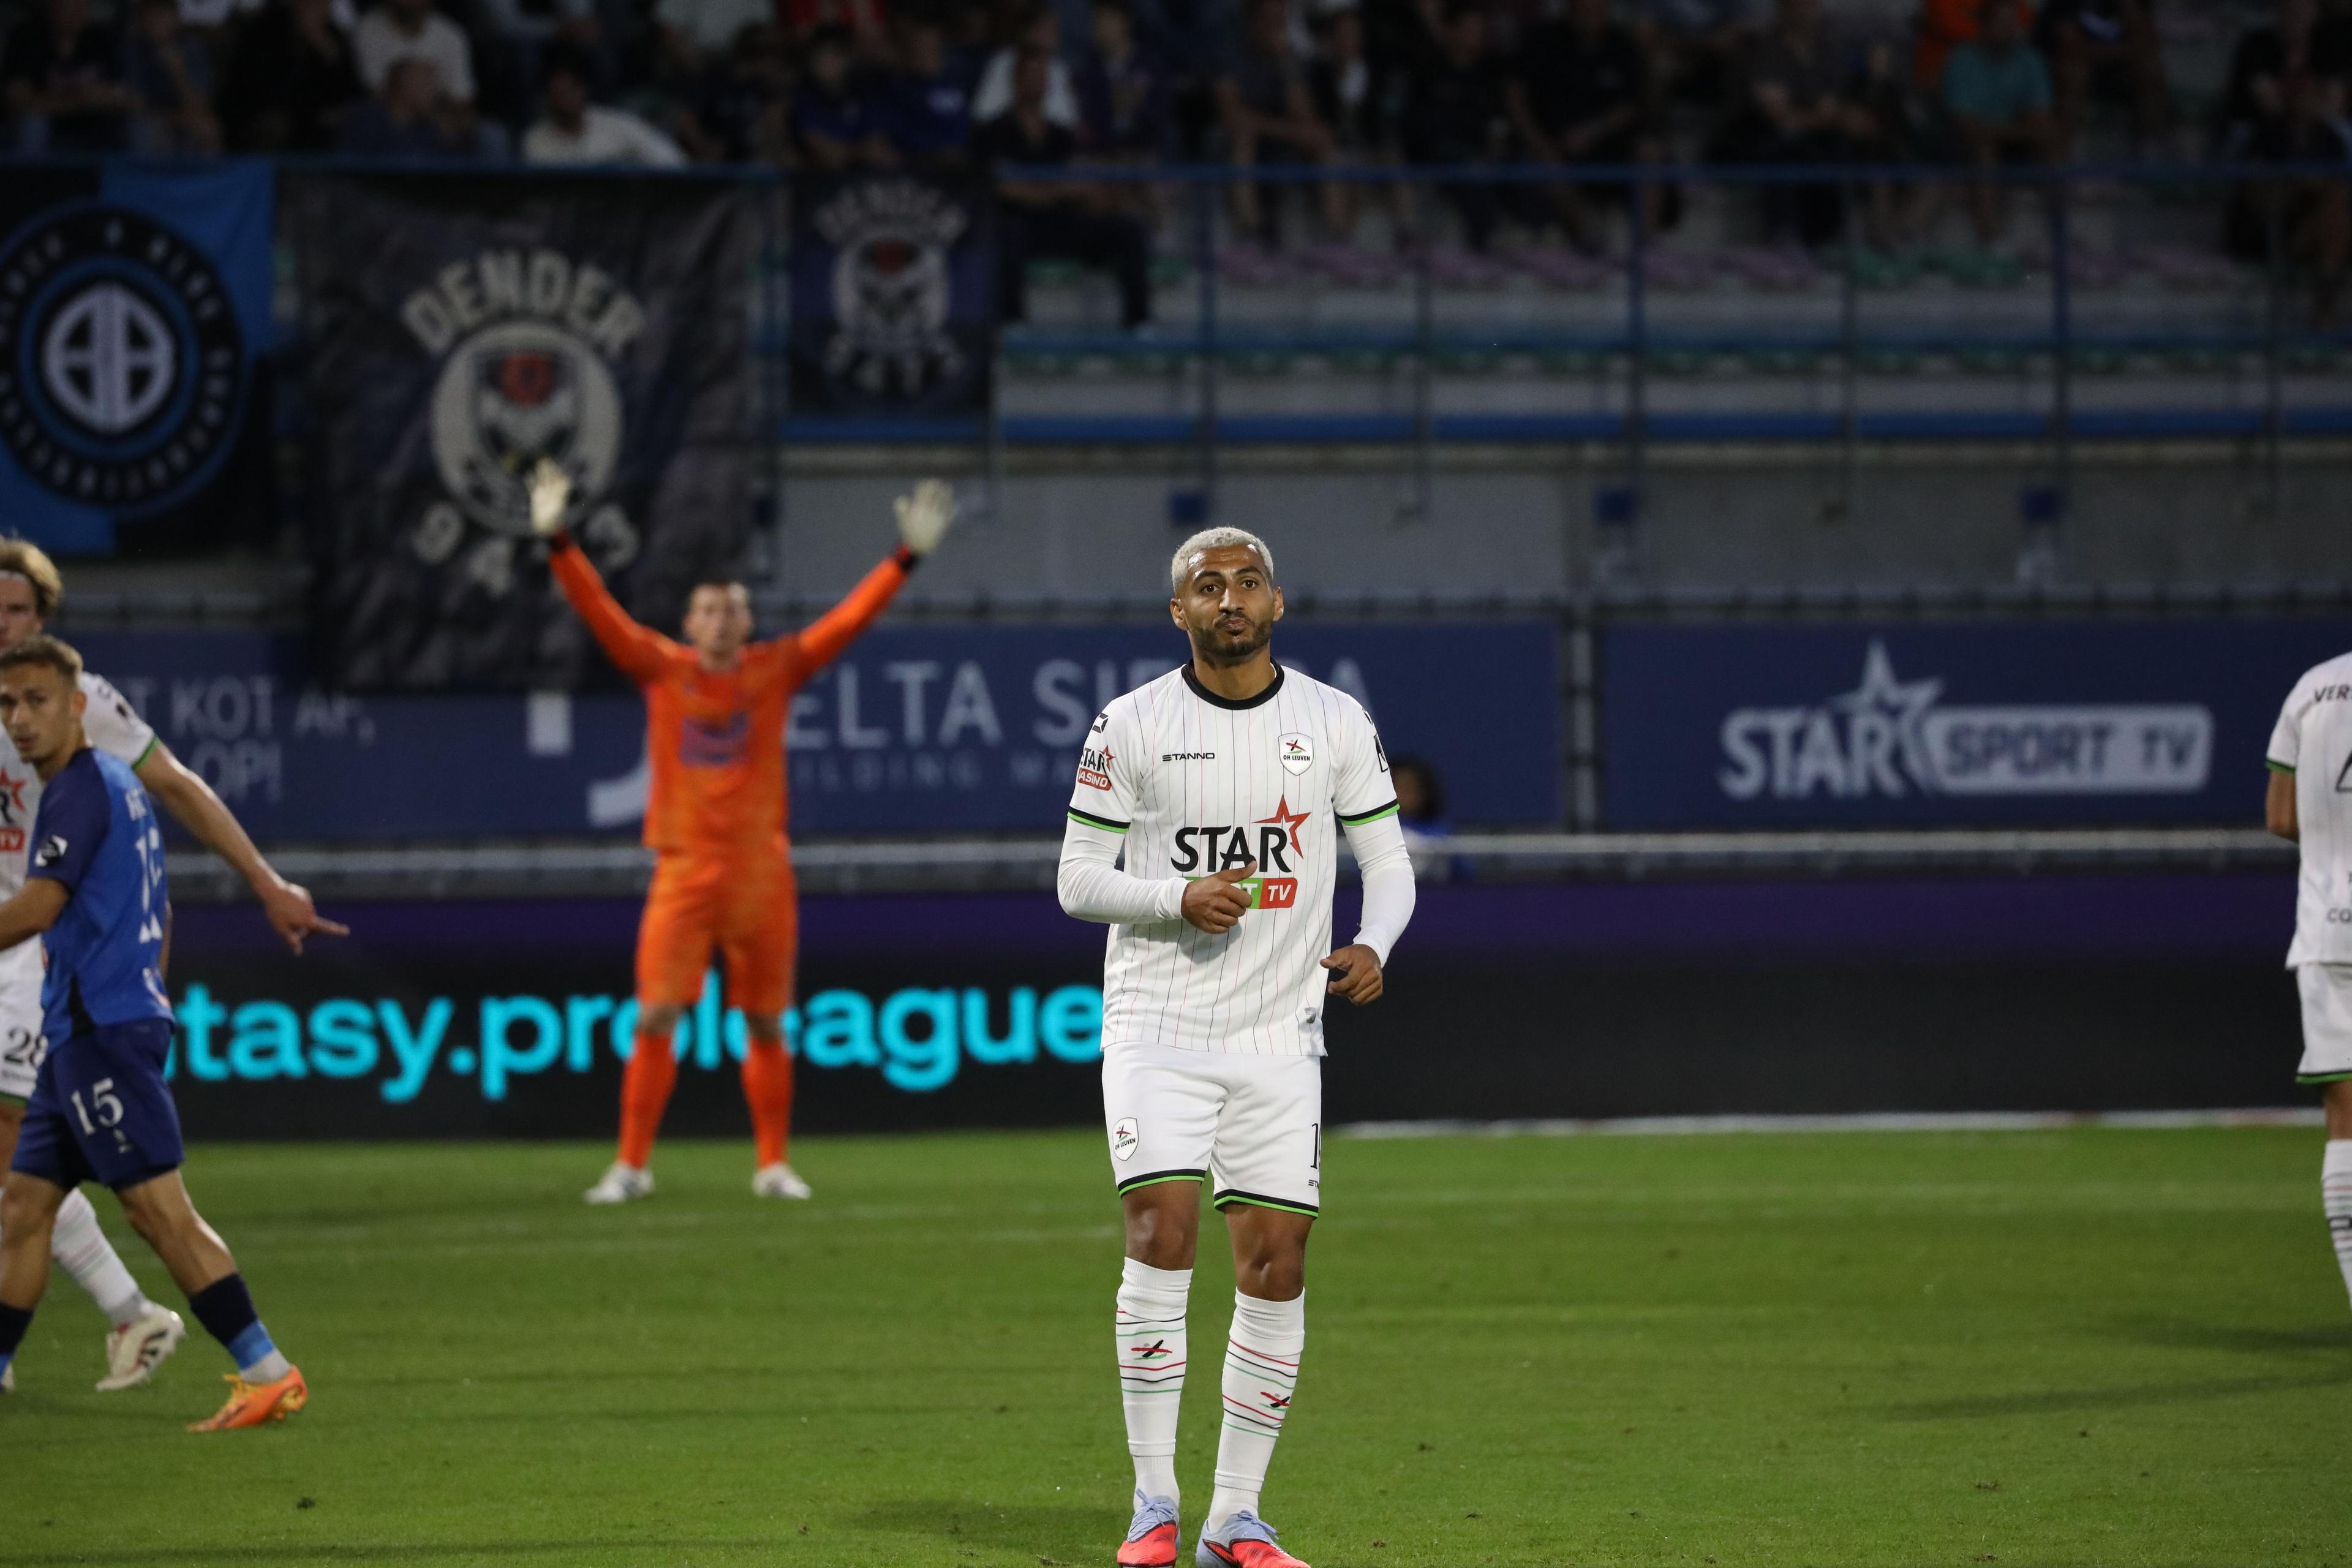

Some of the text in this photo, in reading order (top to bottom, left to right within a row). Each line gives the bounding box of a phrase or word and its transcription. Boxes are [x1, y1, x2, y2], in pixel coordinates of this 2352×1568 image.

[401, 247, 643, 355] DENDER
[788, 658, 1003, 750] ELTA
[1162, 752, 1215, 762] STANNO
[1718, 706, 2201, 800] STAR SPORT TV
[1079, 772, 1108, 788] ASINO
[1170, 825, 1292, 873] STAR
[1267, 884, 1292, 902] TV
[70, 1077, 124, 1135] 15
[1120, 1137, 1136, 1147] LEUVEN
[1310, 1123, 1321, 1169] 1
